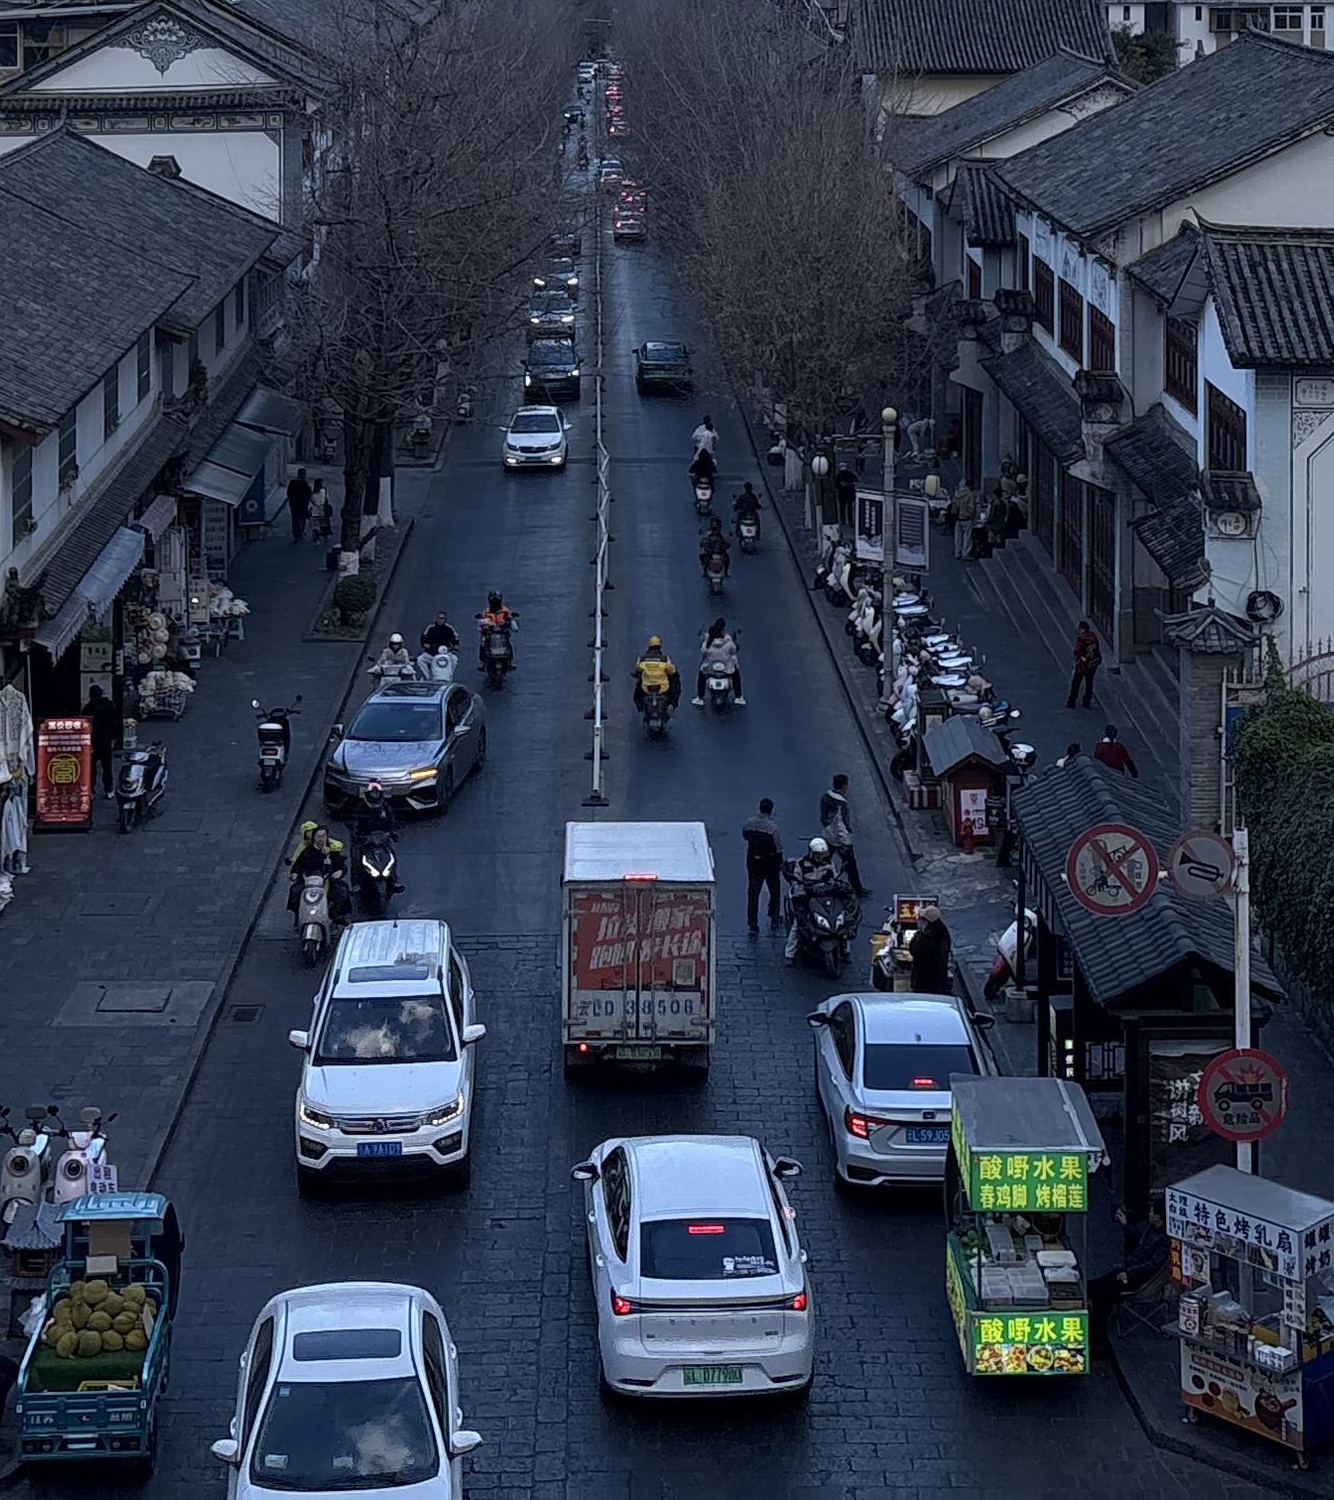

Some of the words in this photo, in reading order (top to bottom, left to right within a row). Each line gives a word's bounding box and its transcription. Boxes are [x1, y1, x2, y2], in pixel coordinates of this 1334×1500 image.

[1223, 1112, 1261, 1126] 危险品
[1193, 1202, 1293, 1256] 特色烤乳扇
